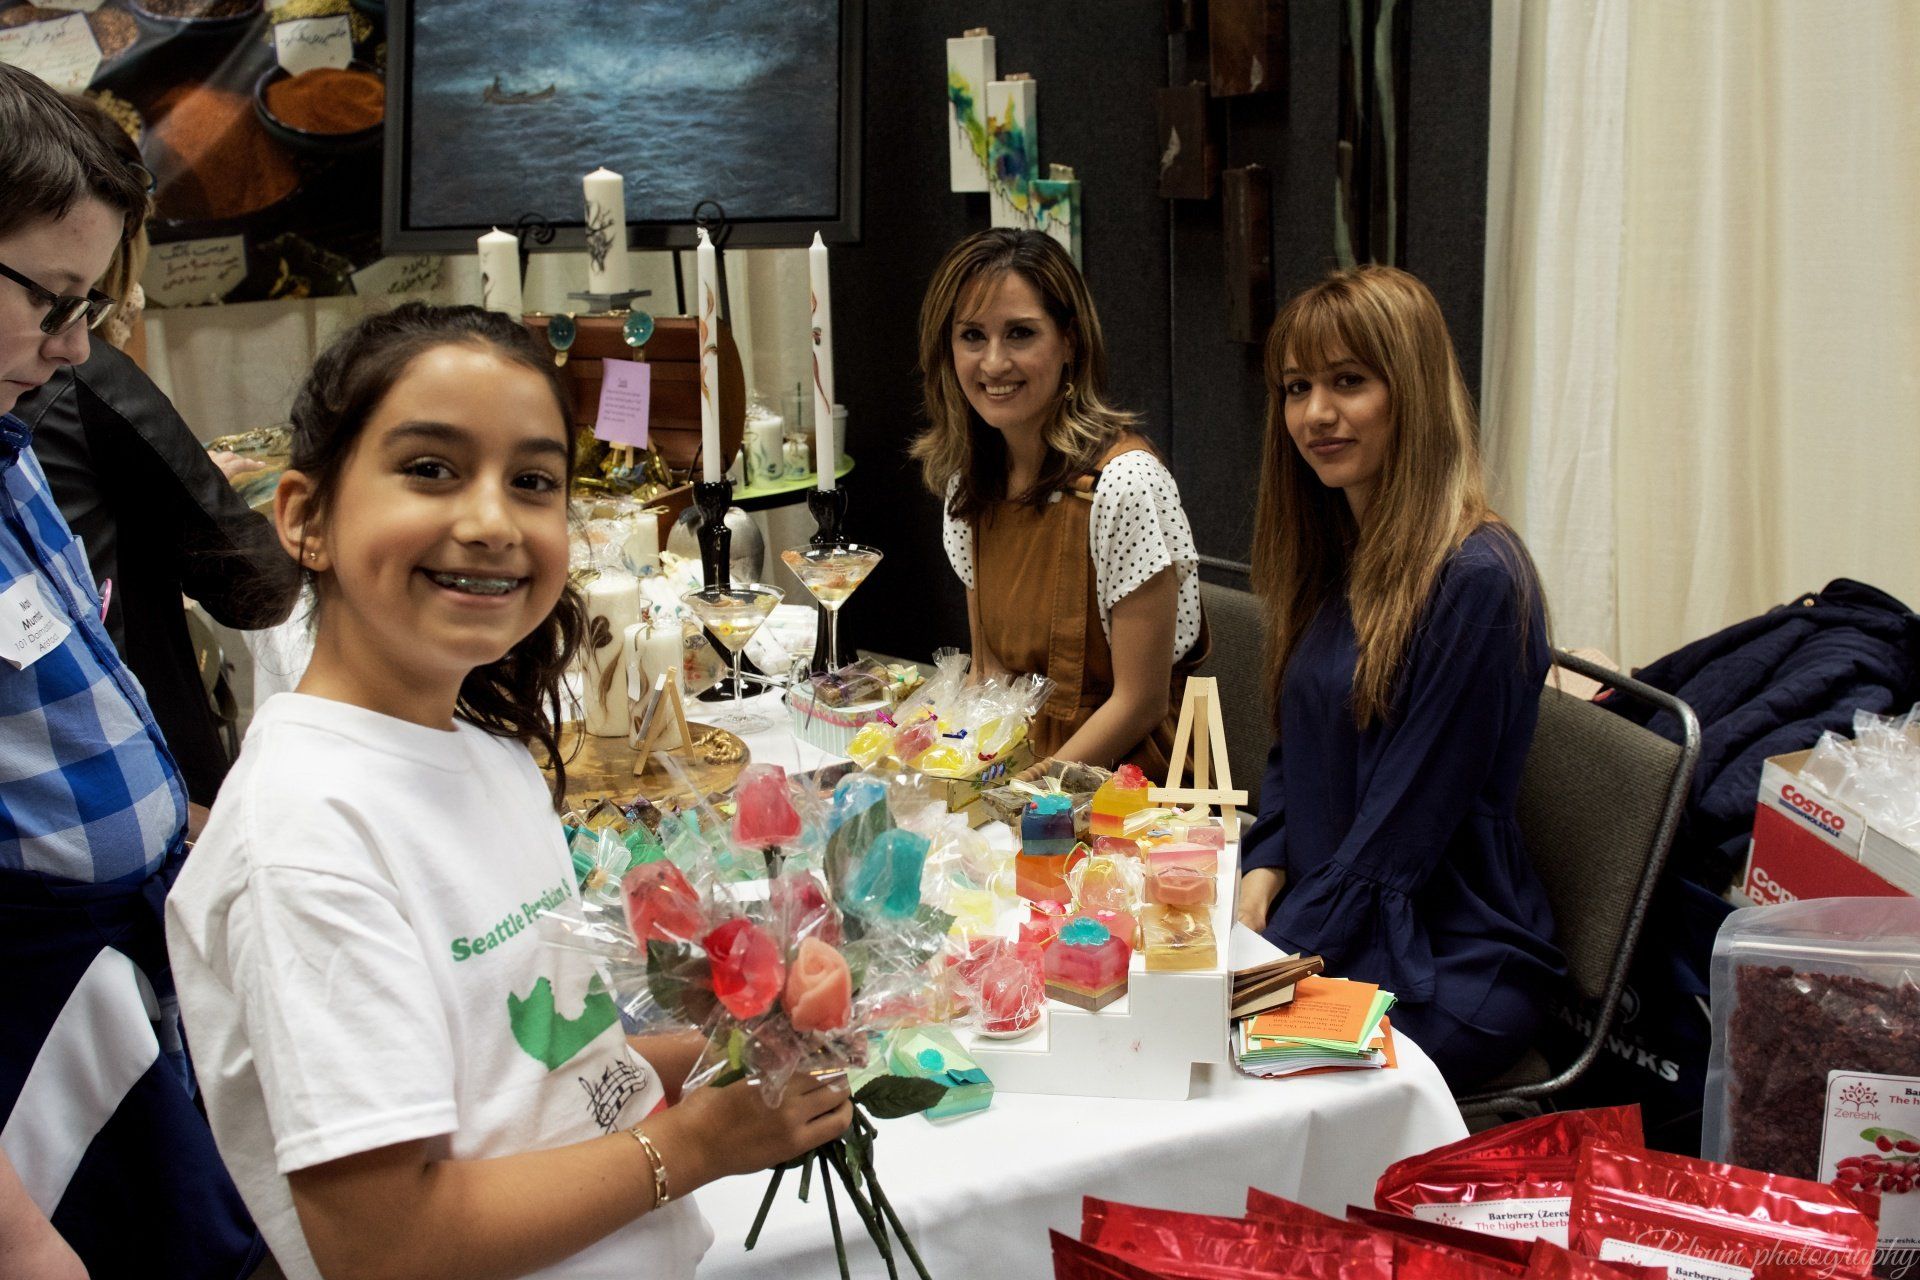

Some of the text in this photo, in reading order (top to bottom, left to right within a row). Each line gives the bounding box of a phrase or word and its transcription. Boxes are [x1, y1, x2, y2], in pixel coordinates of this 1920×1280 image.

[1781, 784, 1845, 831] COSTCO
[450, 912, 525, 962] Seattle
[521, 886, 566, 924] Persian
[1889, 1095, 1910, 1104] The
[1834, 1108, 1881, 1121] Zereshk
[1488, 1212, 1534, 1221] Barberry
[1475, 1219, 1570, 1231] The highest berb
